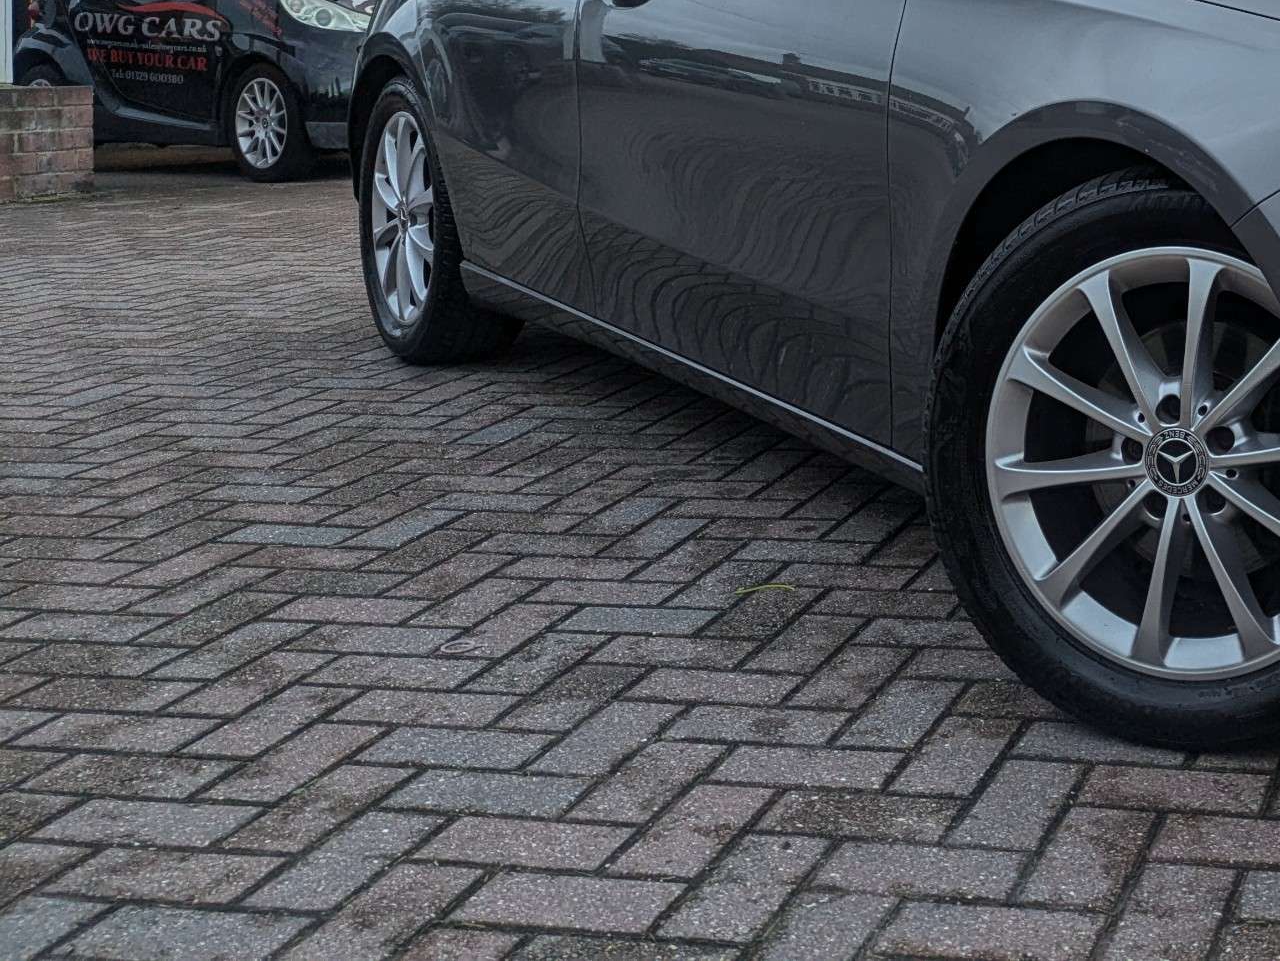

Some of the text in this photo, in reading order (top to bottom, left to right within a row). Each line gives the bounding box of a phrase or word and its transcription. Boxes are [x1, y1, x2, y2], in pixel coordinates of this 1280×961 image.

[74, 11, 222, 42] OWG CARS
[177, 55, 208, 72] CAR
